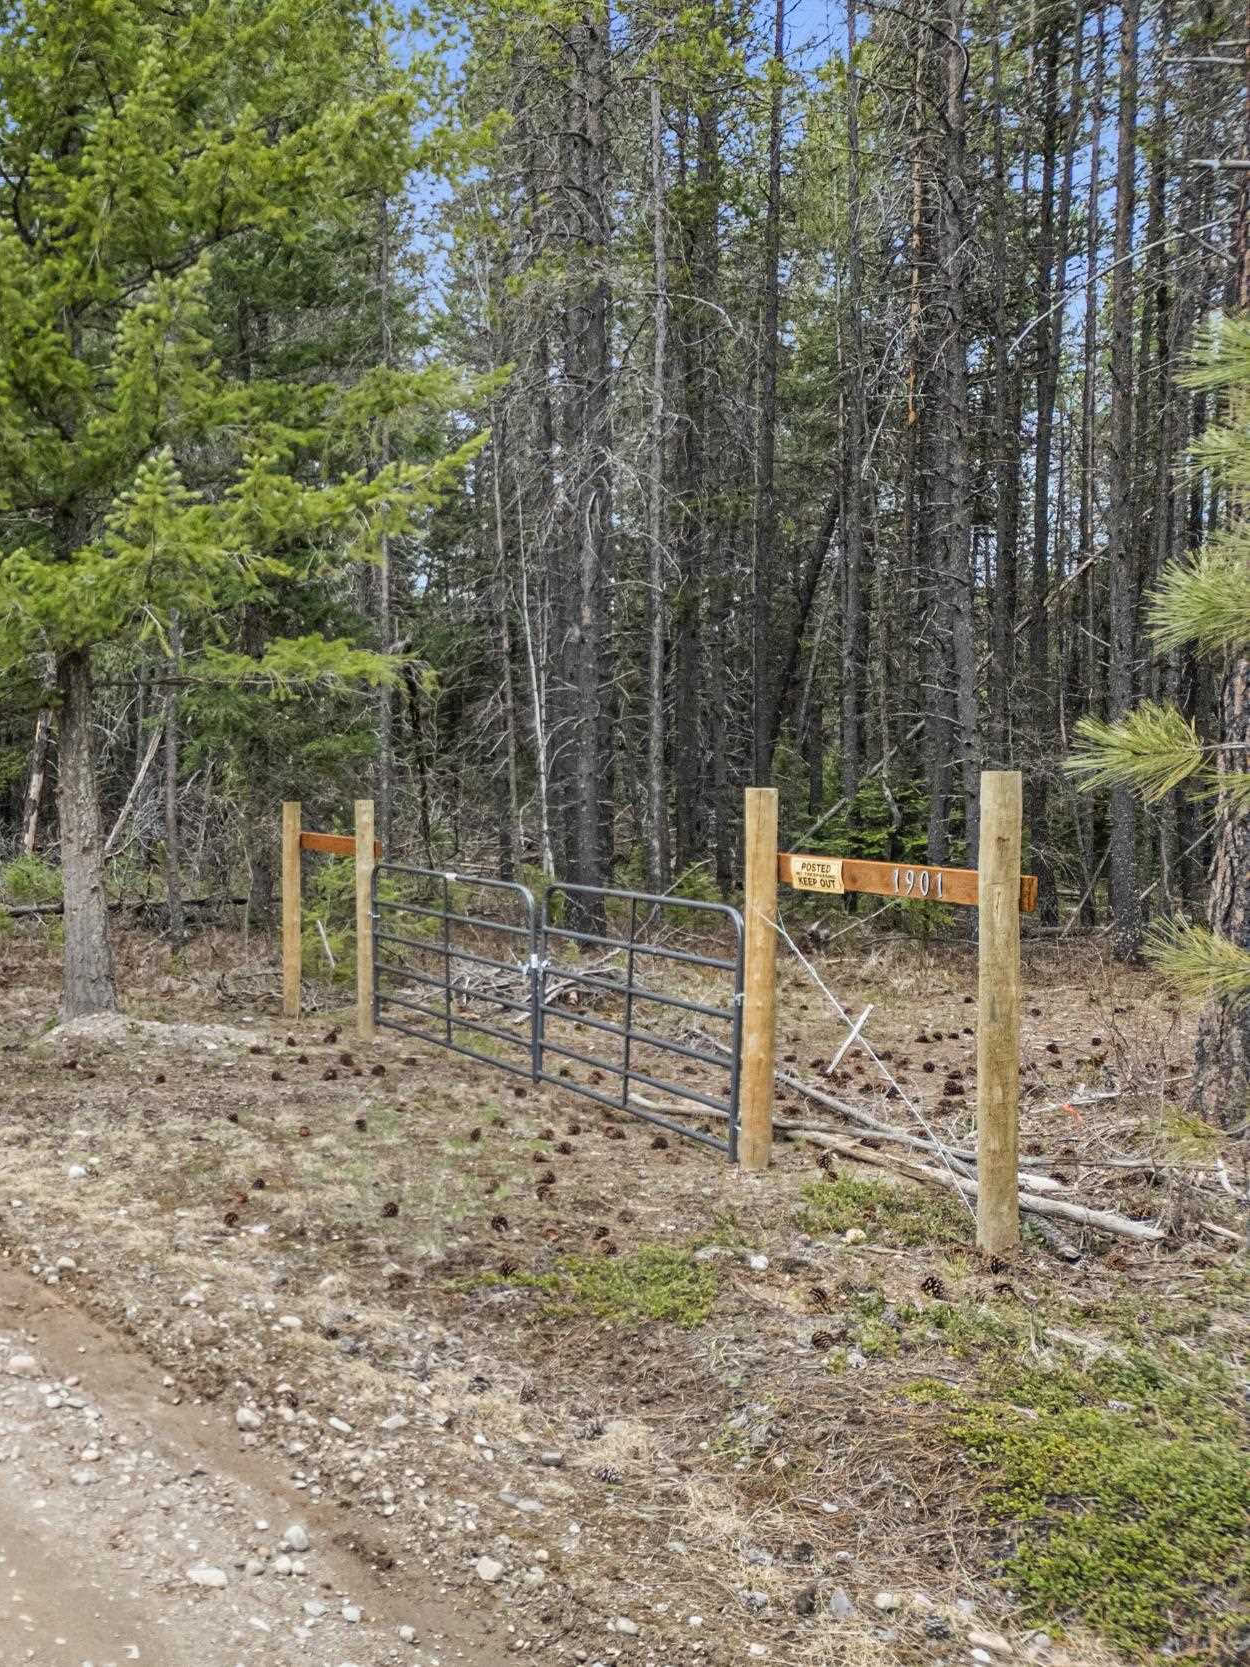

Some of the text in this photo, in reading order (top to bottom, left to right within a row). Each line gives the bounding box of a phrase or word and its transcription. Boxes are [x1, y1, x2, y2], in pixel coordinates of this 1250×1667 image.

[801, 862, 831, 873] POSTED
[798, 876, 835, 888] KEEP OUT
[894, 868, 943, 897] 1901
